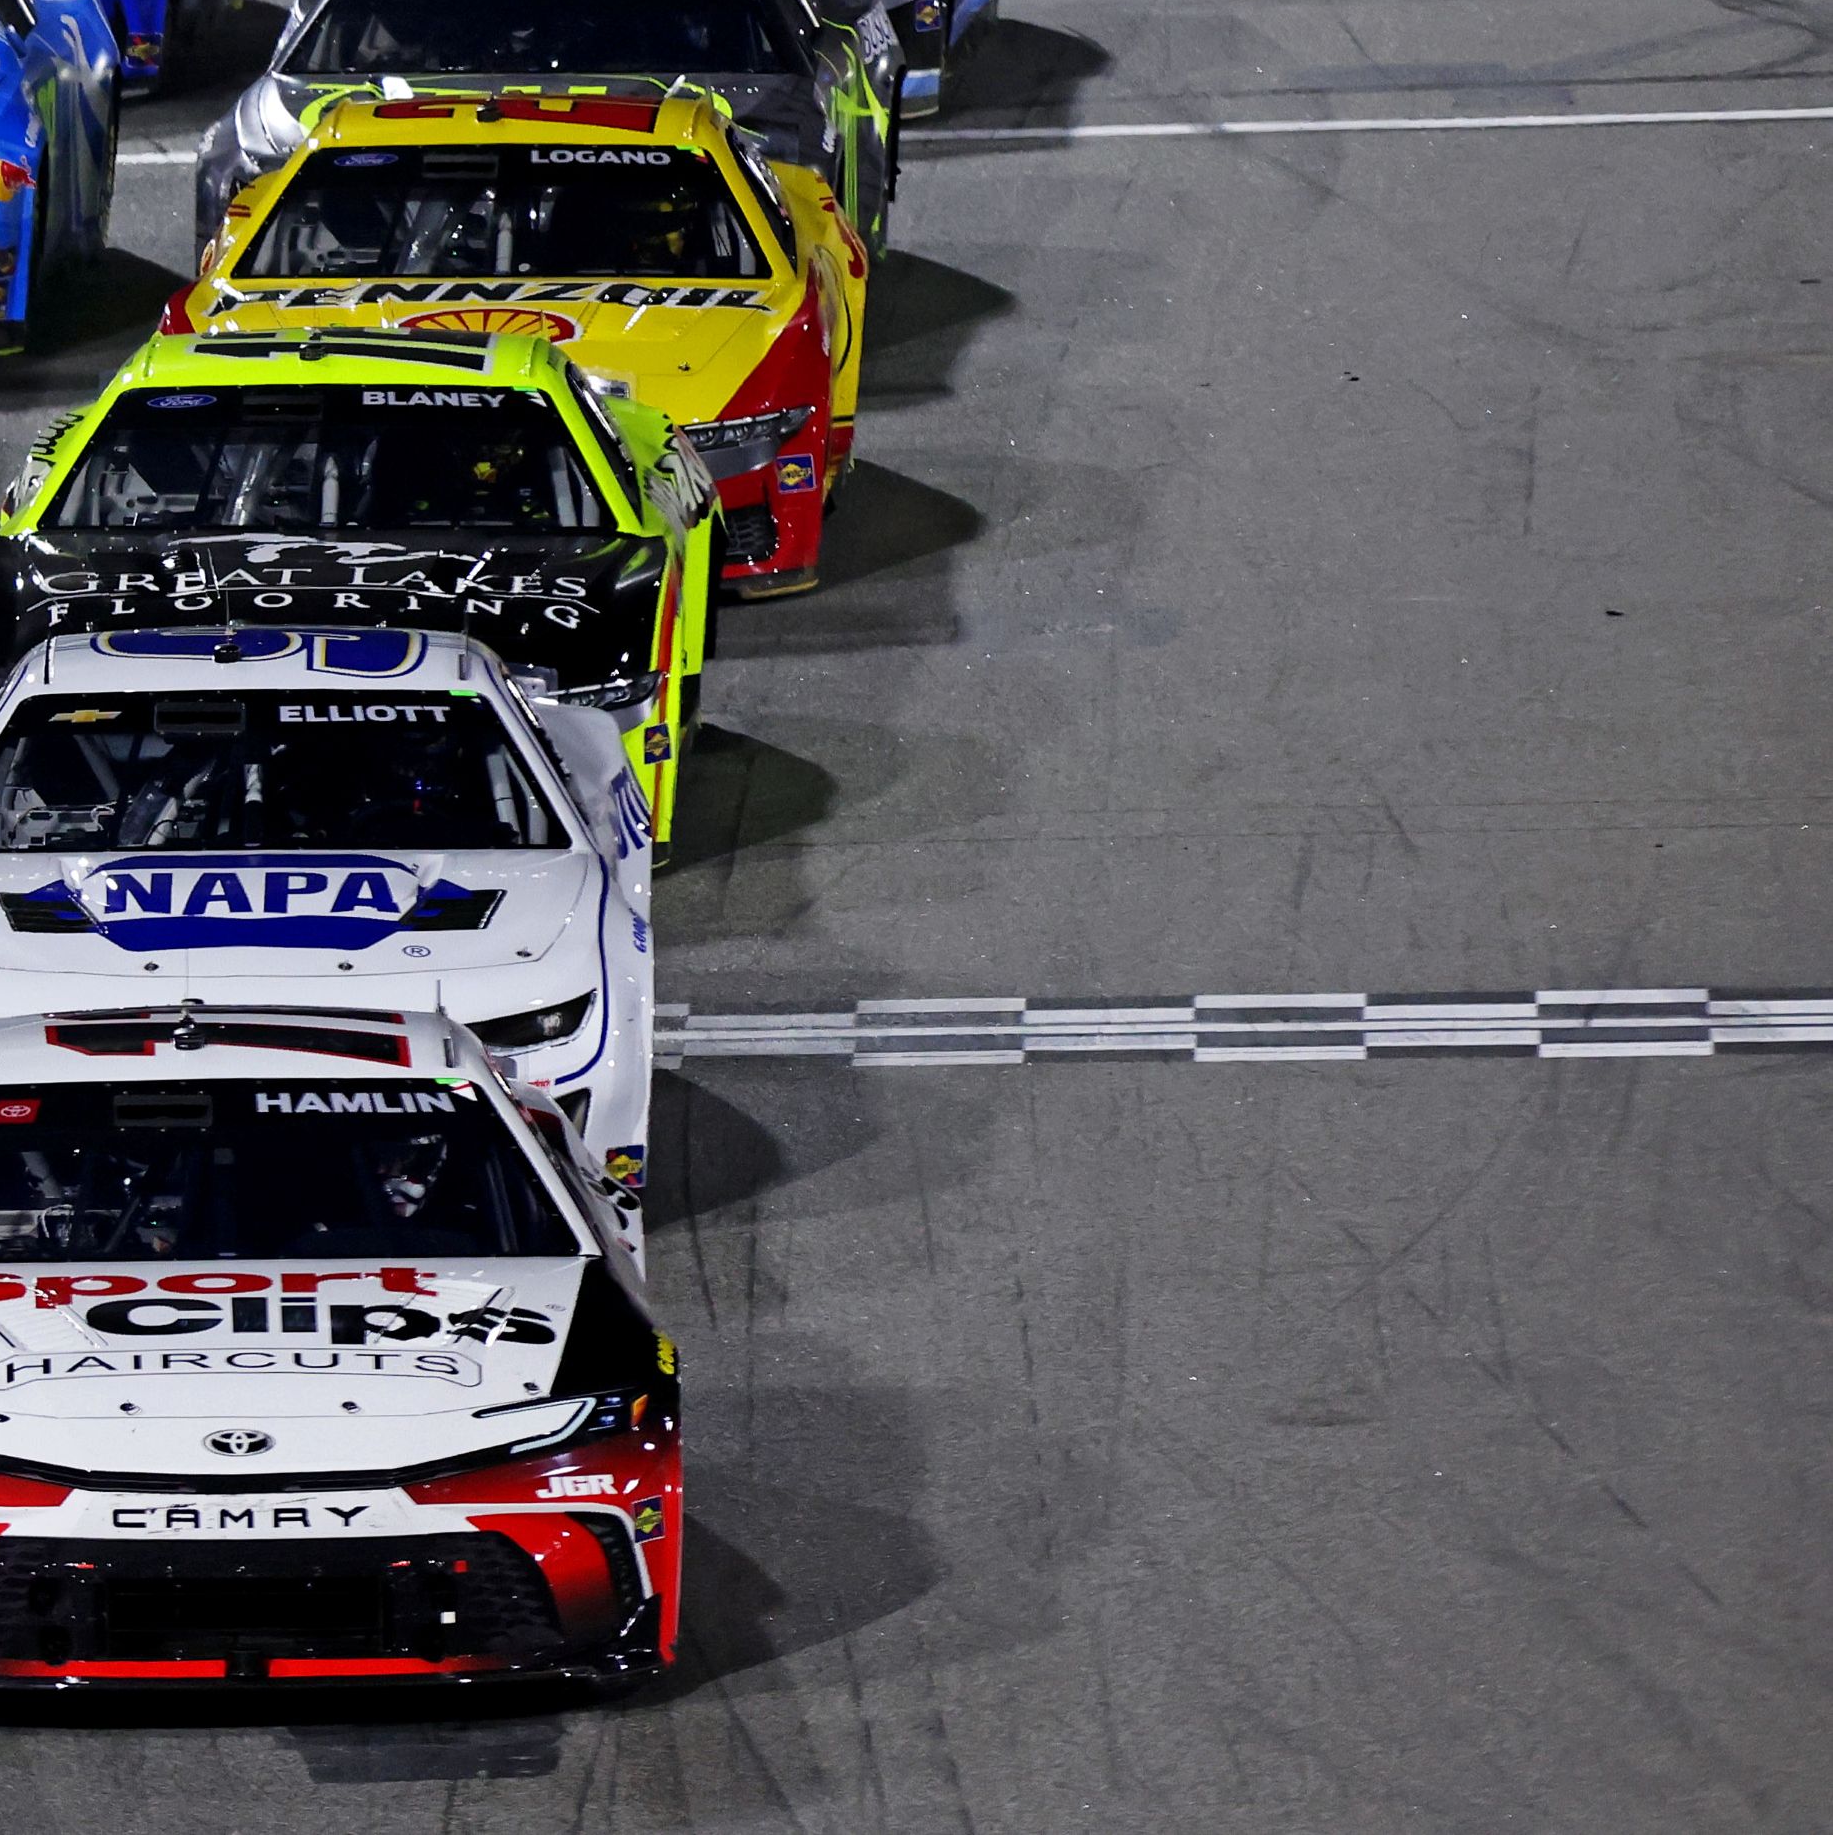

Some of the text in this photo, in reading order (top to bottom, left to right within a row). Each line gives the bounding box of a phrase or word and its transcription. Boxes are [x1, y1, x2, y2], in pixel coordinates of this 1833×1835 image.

[530, 148, 671, 167] LOGANO
[361, 390, 506, 410] BLANEY
[37, 566, 589, 599] GREAT LAKES
[47, 592, 582, 630] FLOORING
[278, 704, 452, 724] ELLIOTT
[103, 870, 400, 917] NAPA
[254, 1092, 457, 1116] HAMLIN
[4, 1350, 462, 1385] HAIRCUTS
[535, 1473, 619, 1499] JGR
[112, 1505, 372, 1530] CAMRY
